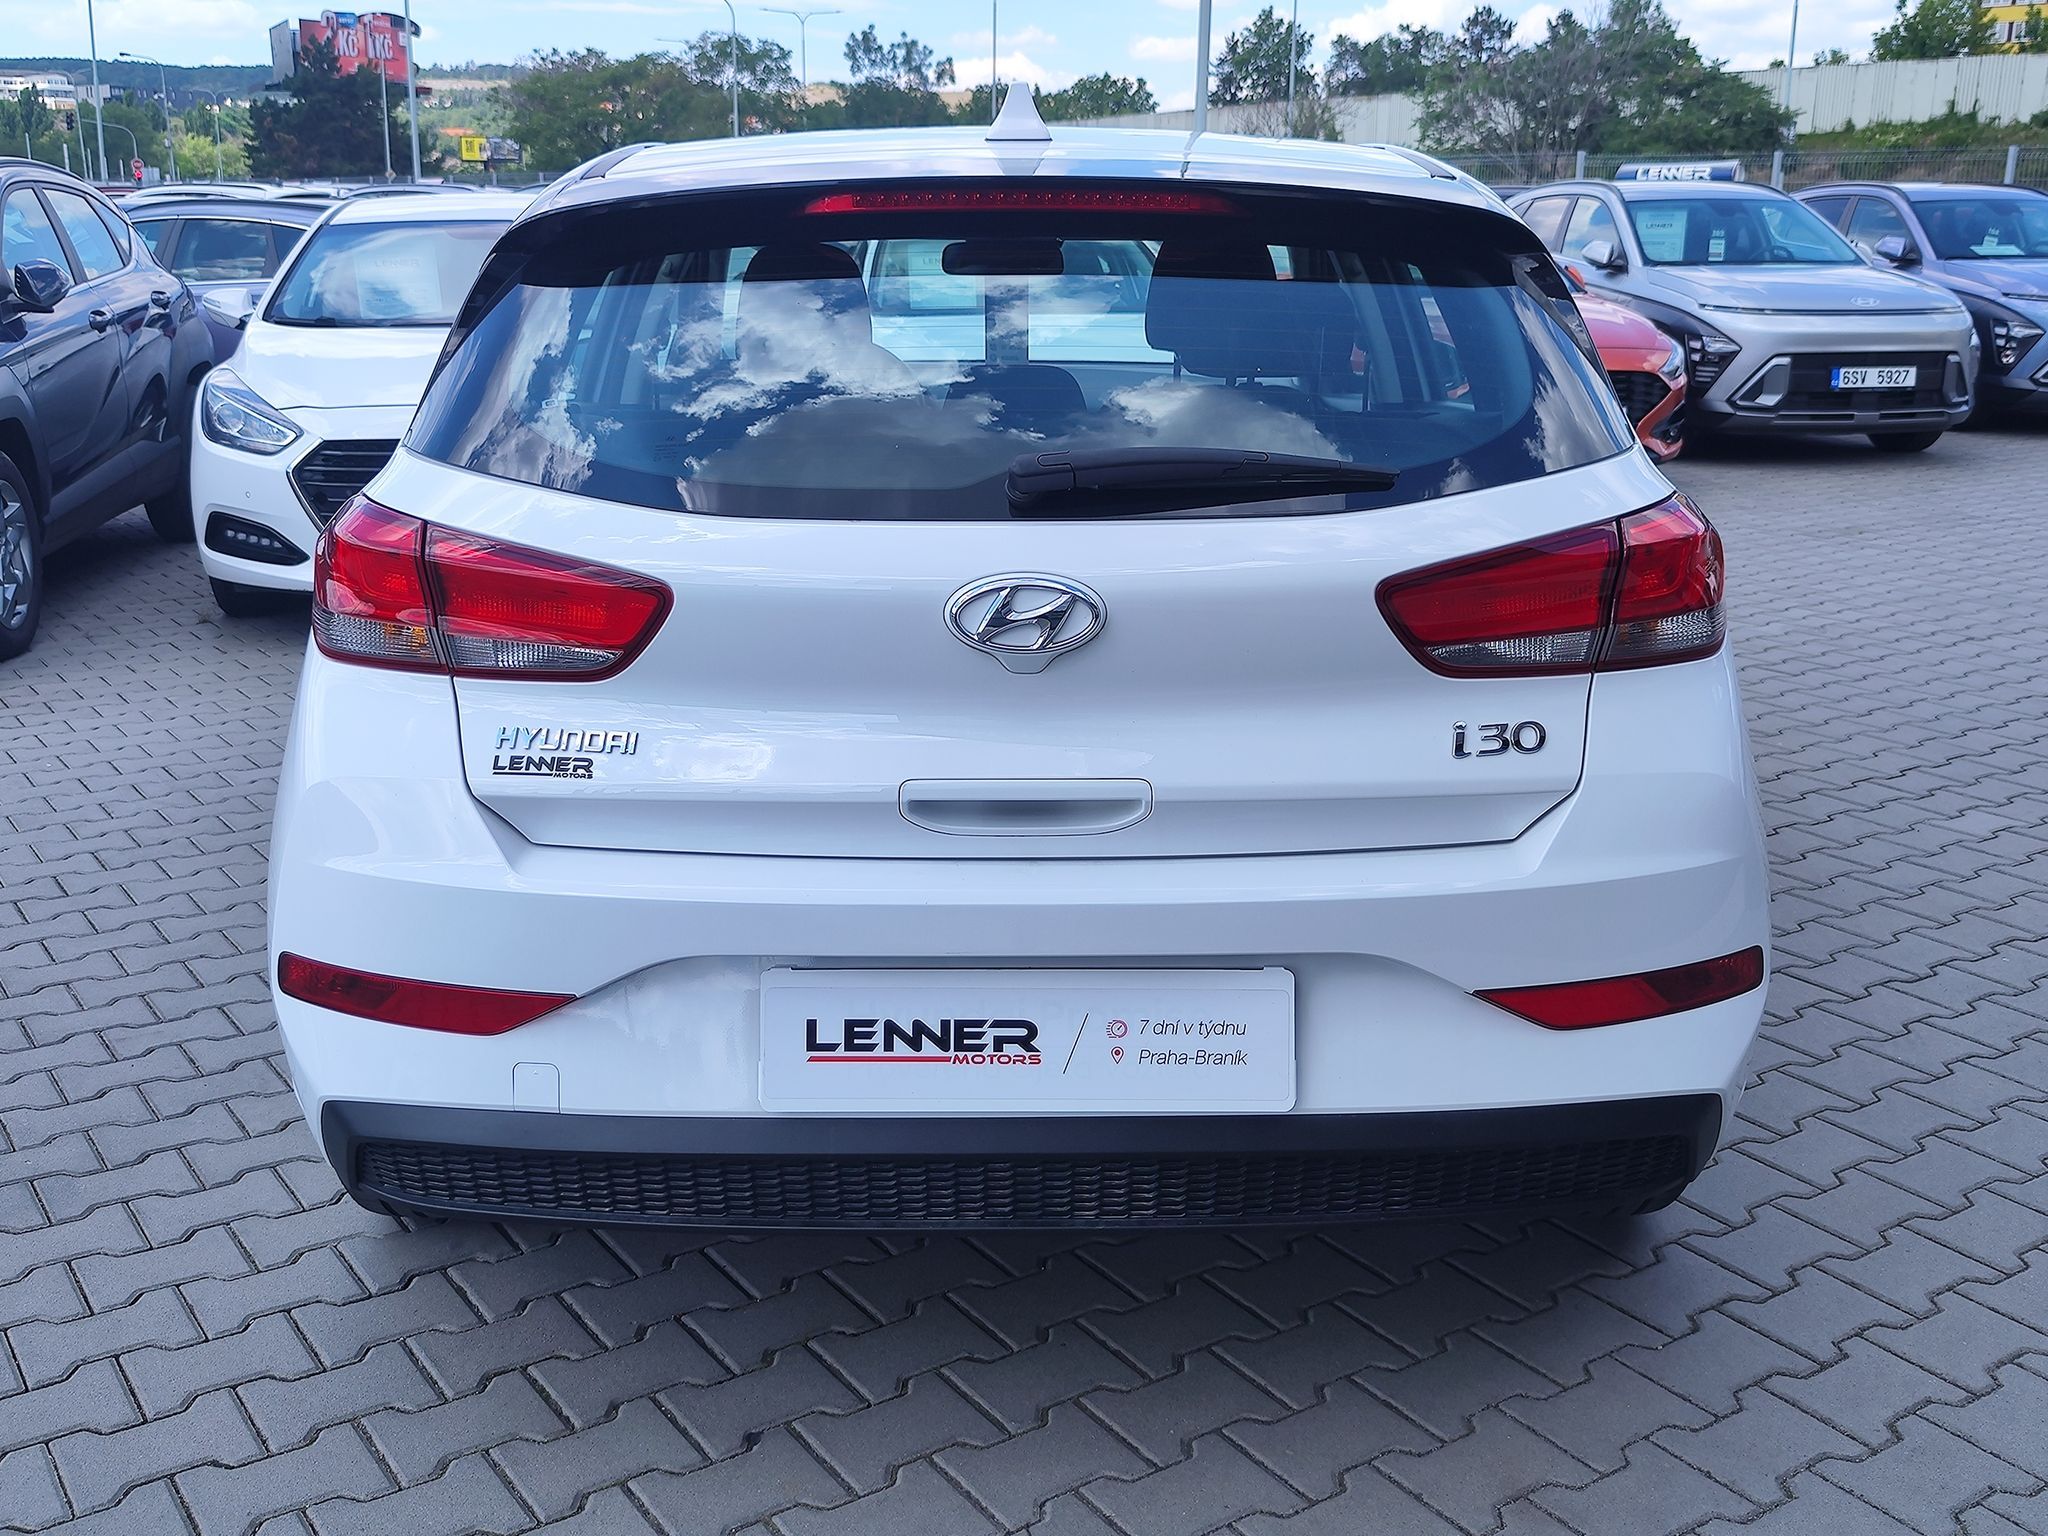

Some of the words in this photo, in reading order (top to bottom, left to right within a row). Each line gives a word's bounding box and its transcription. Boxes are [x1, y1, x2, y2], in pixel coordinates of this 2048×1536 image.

[1636, 166, 1712, 181] LENNER
[1842, 370, 1868, 385] 6SV
[1877, 369, 1910, 385] 5927
[495, 726, 639, 755] HYUNDAI
[1452, 720, 1547, 759] i30
[493, 755, 594, 772] LENNER
[553, 772, 594, 780] MOTORS
[805, 1018, 1041, 1053] LENNER
[1140, 1019, 1150, 1035] 7
[1152, 1019, 1181, 1036] dní
[1183, 1022, 1194, 1036] v
[1198, 1019, 1247, 1040] týdnu
[951, 1053, 1042, 1066] MOTORS
[1138, 1049, 1249, 1066] Praha-Braník
